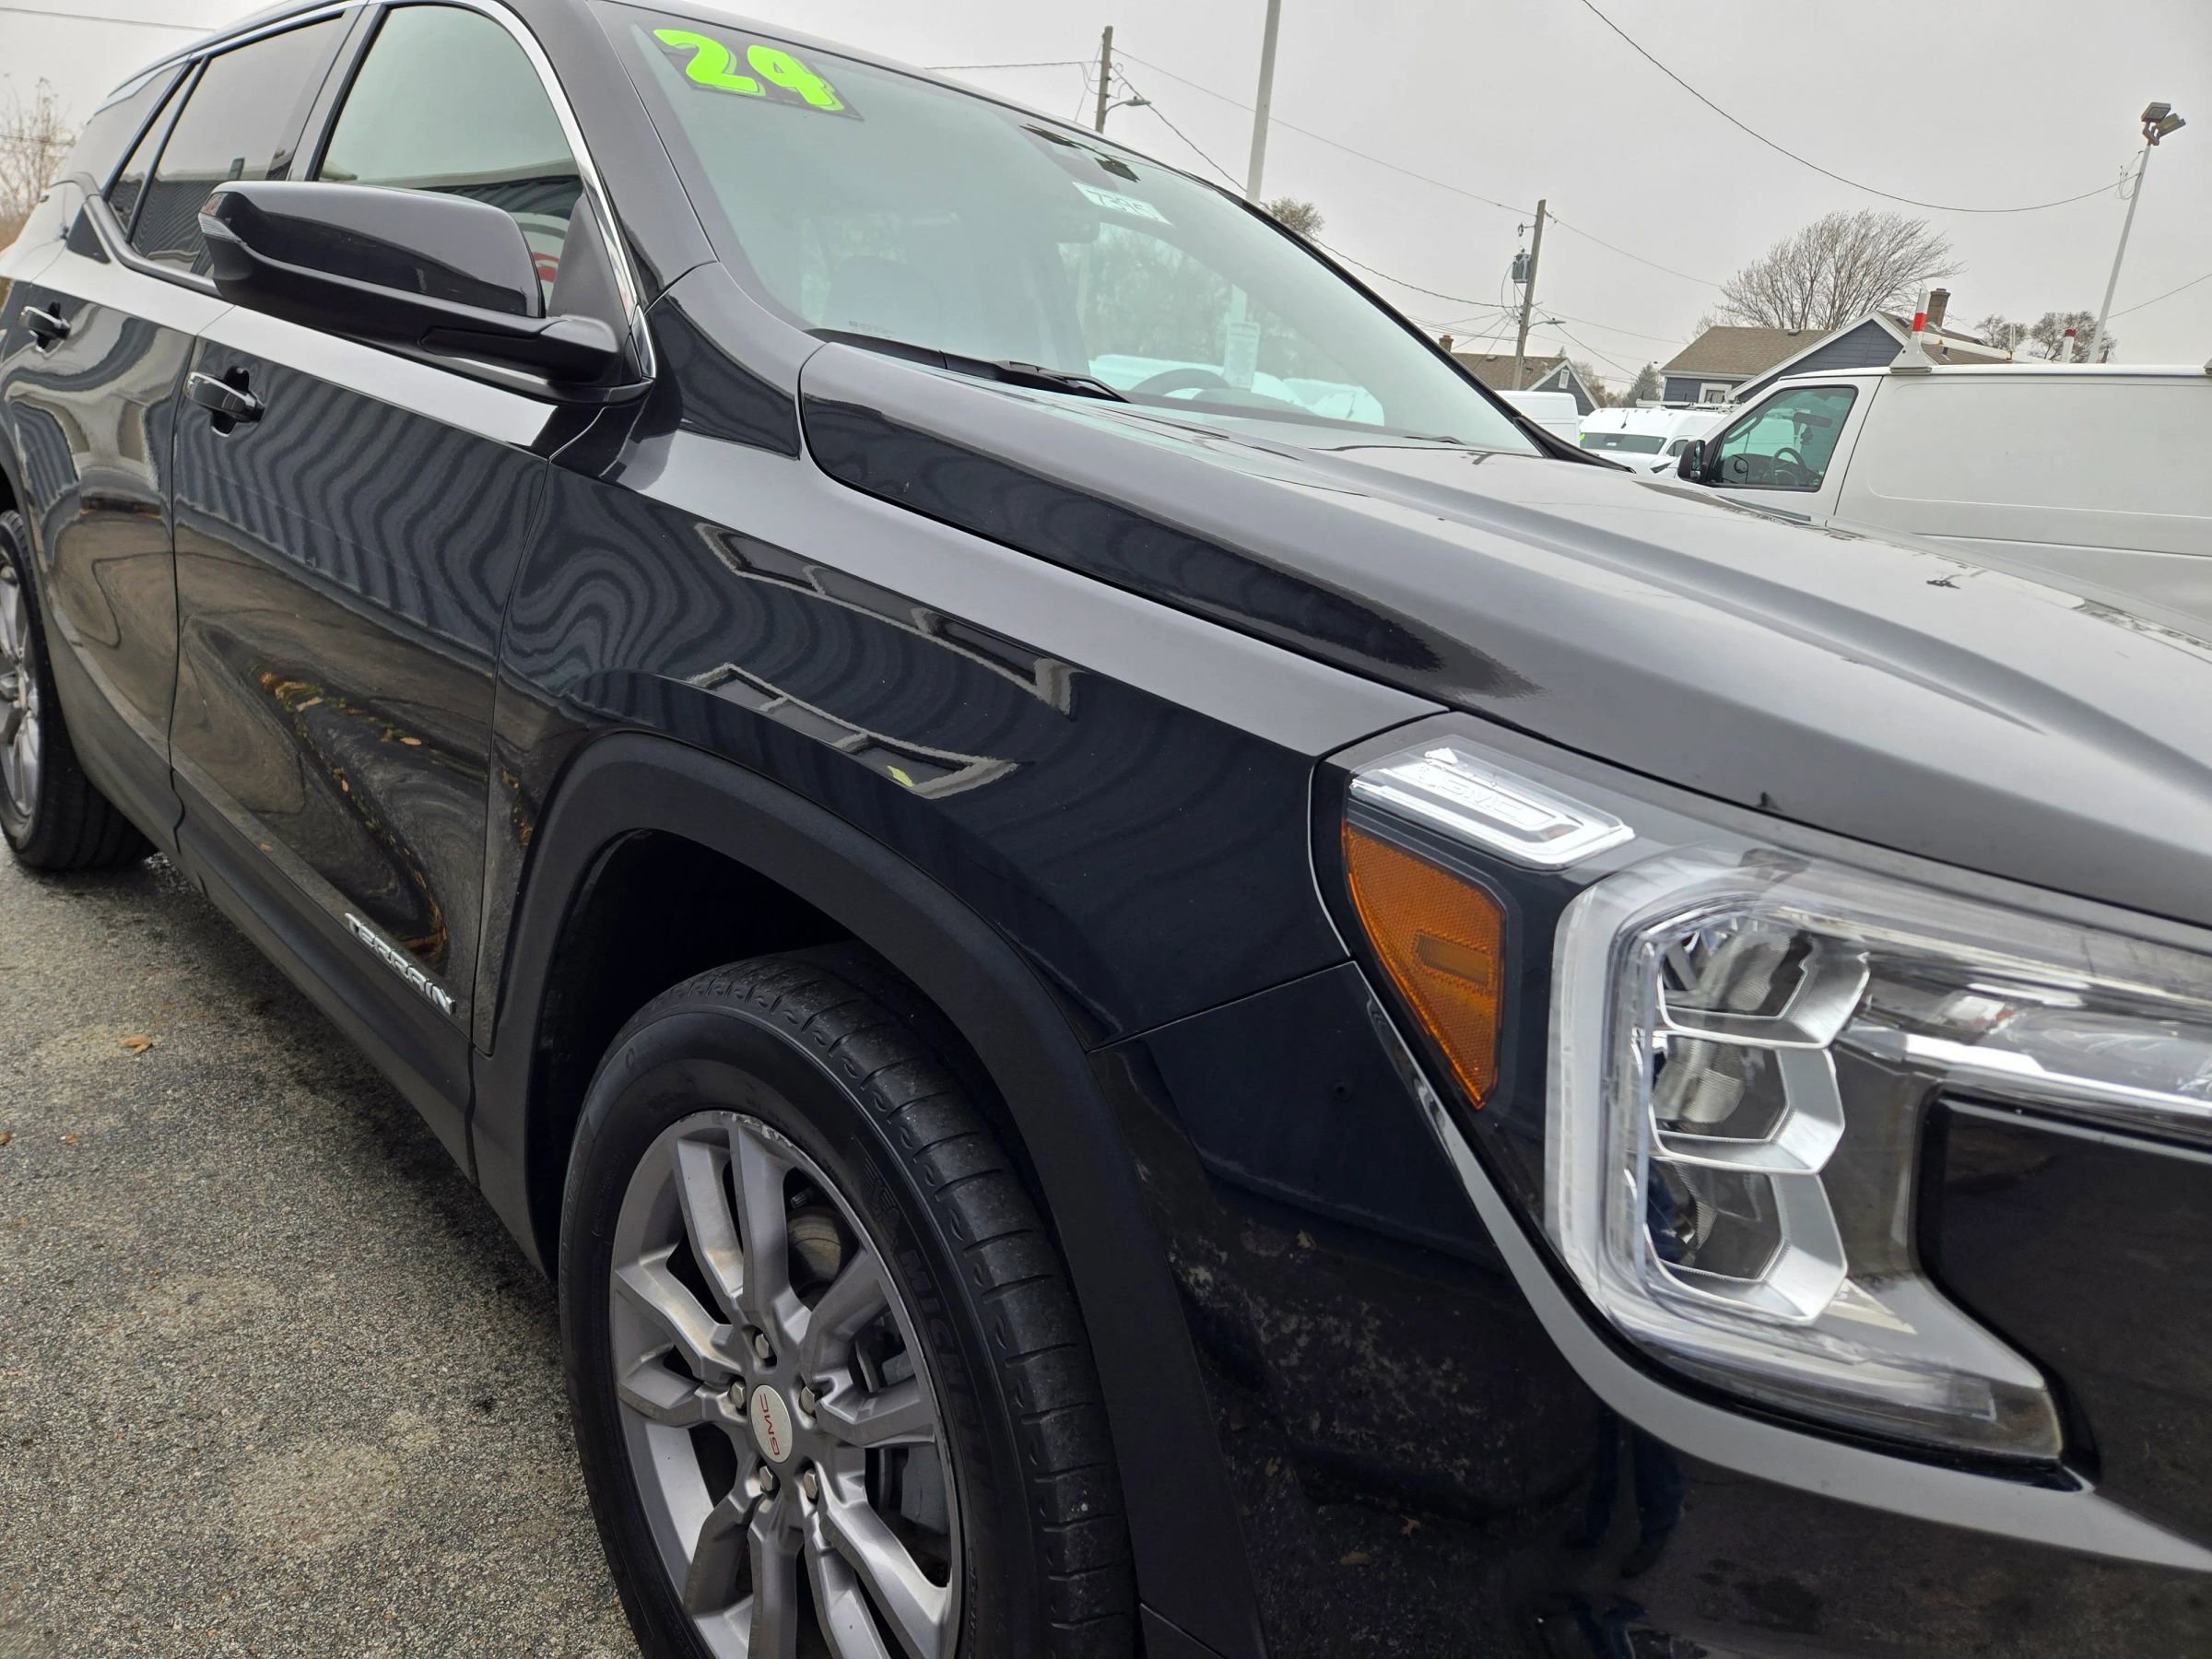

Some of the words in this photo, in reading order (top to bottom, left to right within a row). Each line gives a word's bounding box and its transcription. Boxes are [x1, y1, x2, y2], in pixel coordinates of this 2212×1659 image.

[653, 29, 842, 110] 24
[1438, 779, 1524, 819] GMC
[345, 912, 456, 1015] TERRAIN
[759, 1393, 780, 1455] GMC
